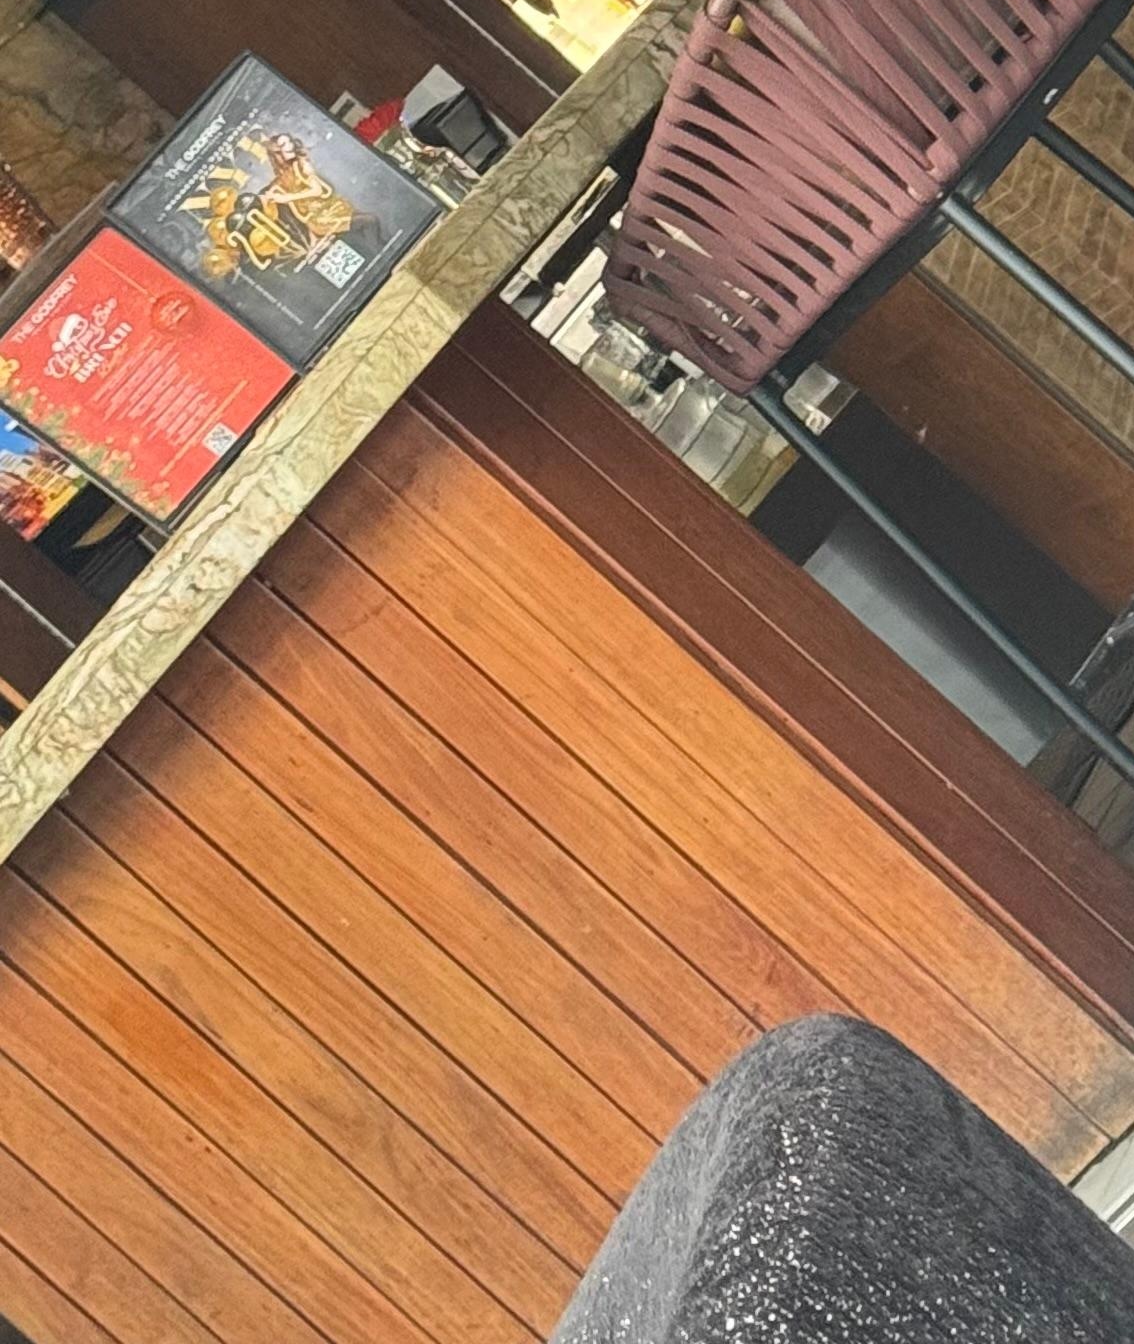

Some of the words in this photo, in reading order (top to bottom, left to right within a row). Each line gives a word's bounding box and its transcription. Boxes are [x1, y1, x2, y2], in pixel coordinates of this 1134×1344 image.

[164, 158, 188, 180] THE
[183, 115, 227, 161] GODFREY
[11, 320, 35, 344] THE
[33, 273, 78, 325] GODFREY
